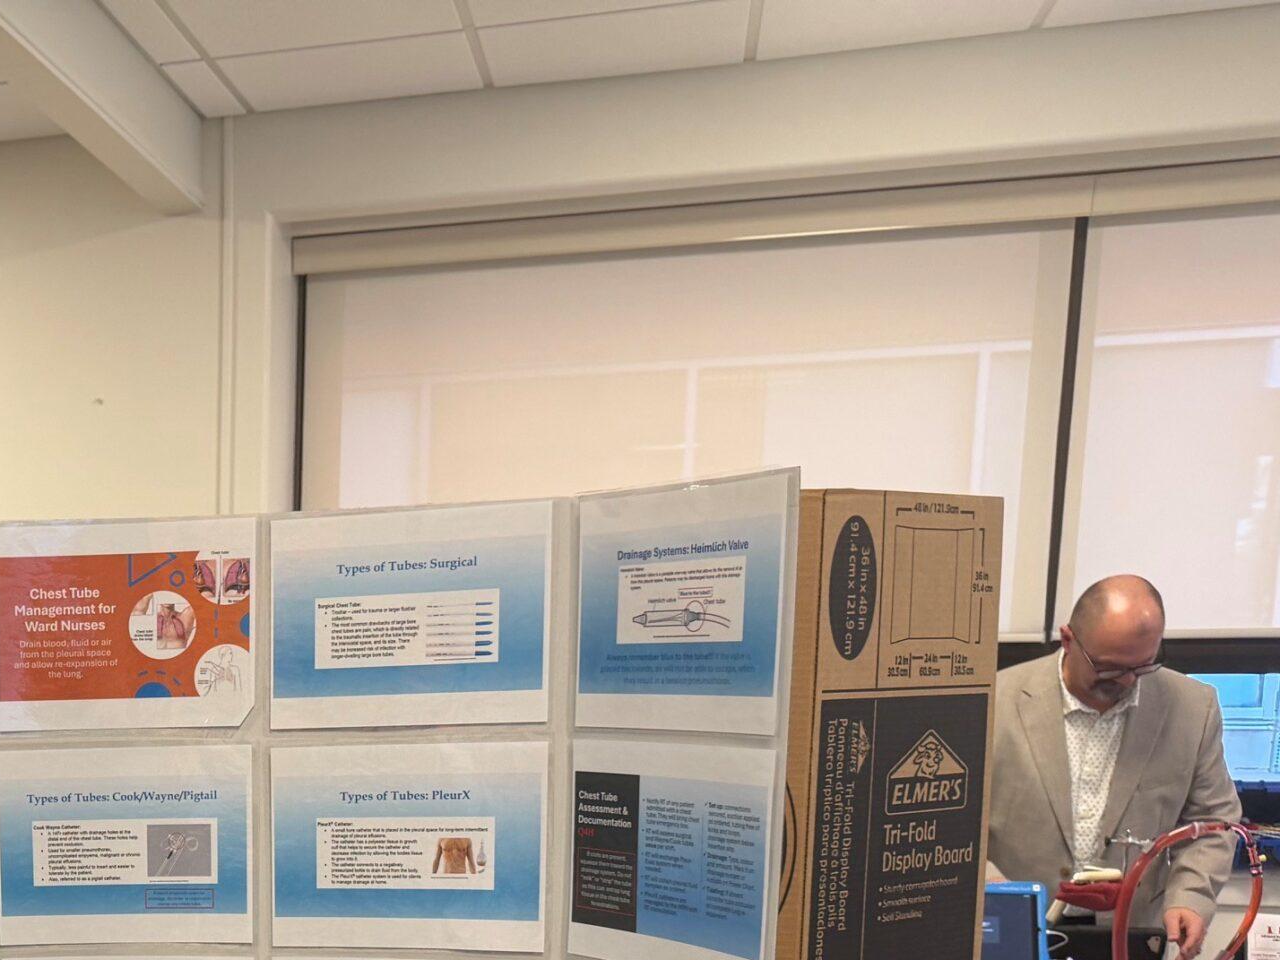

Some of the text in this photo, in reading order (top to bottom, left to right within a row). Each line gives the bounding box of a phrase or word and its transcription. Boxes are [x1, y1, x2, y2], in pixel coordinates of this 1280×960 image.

[617, 539, 749, 560] Drainage Systems: Heimlich Valve
[336, 556, 477, 577] Types of Tubes: Surgical
[30, 588, 100, 599] Chest Tube
[15, 603, 116, 620] Management for
[25, 620, 105, 632] Ward Nurses
[20, 640, 41, 648] Drain
[43, 639, 68, 648] blood,
[71, 639, 89, 647] fluid
[102, 638, 112, 646] air
[20, 649, 111, 660] from the pleural space
[14, 659, 118, 670] and allow re-expansion of
[48, 670, 83, 680] the lung.
[27, 790, 217, 805] Types of Tubes: Cook/Wayne/Pigtail
[340, 790, 470, 804] Types of Tubes: PleurX
[579, 790, 618, 802] Chest Tube
[891, 777, 962, 806] ELMER'S
[578, 802, 628, 815] Assessment &
[578, 815, 632, 828] Documentation
[883, 820, 936, 845] Tri-Fold
[836, 781, 856, 931] Tri-Fold Display Board
[882, 841, 973, 875] Display Board
